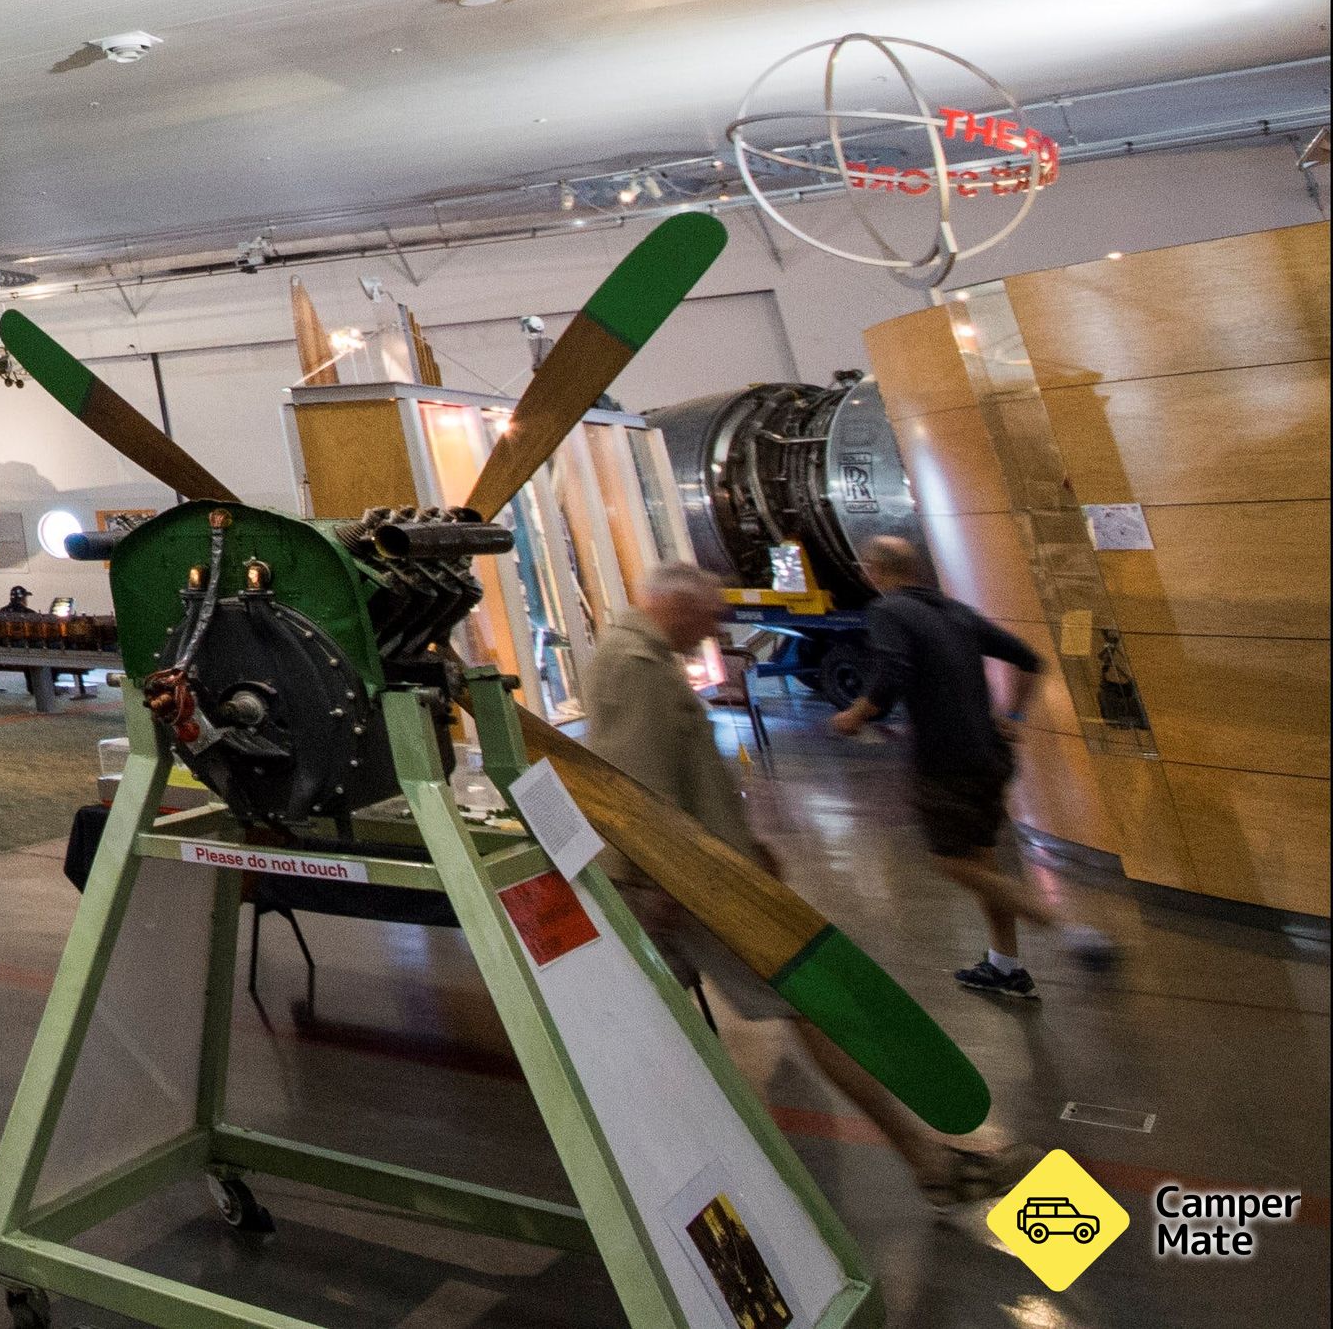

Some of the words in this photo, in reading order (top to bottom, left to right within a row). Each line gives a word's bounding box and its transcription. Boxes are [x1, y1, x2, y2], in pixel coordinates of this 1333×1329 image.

[938, 106, 1019, 152] THE
[195, 847, 243, 867] Please
[248, 854, 267, 869] do
[271, 859, 297, 873] not
[301, 861, 349, 878] touch
